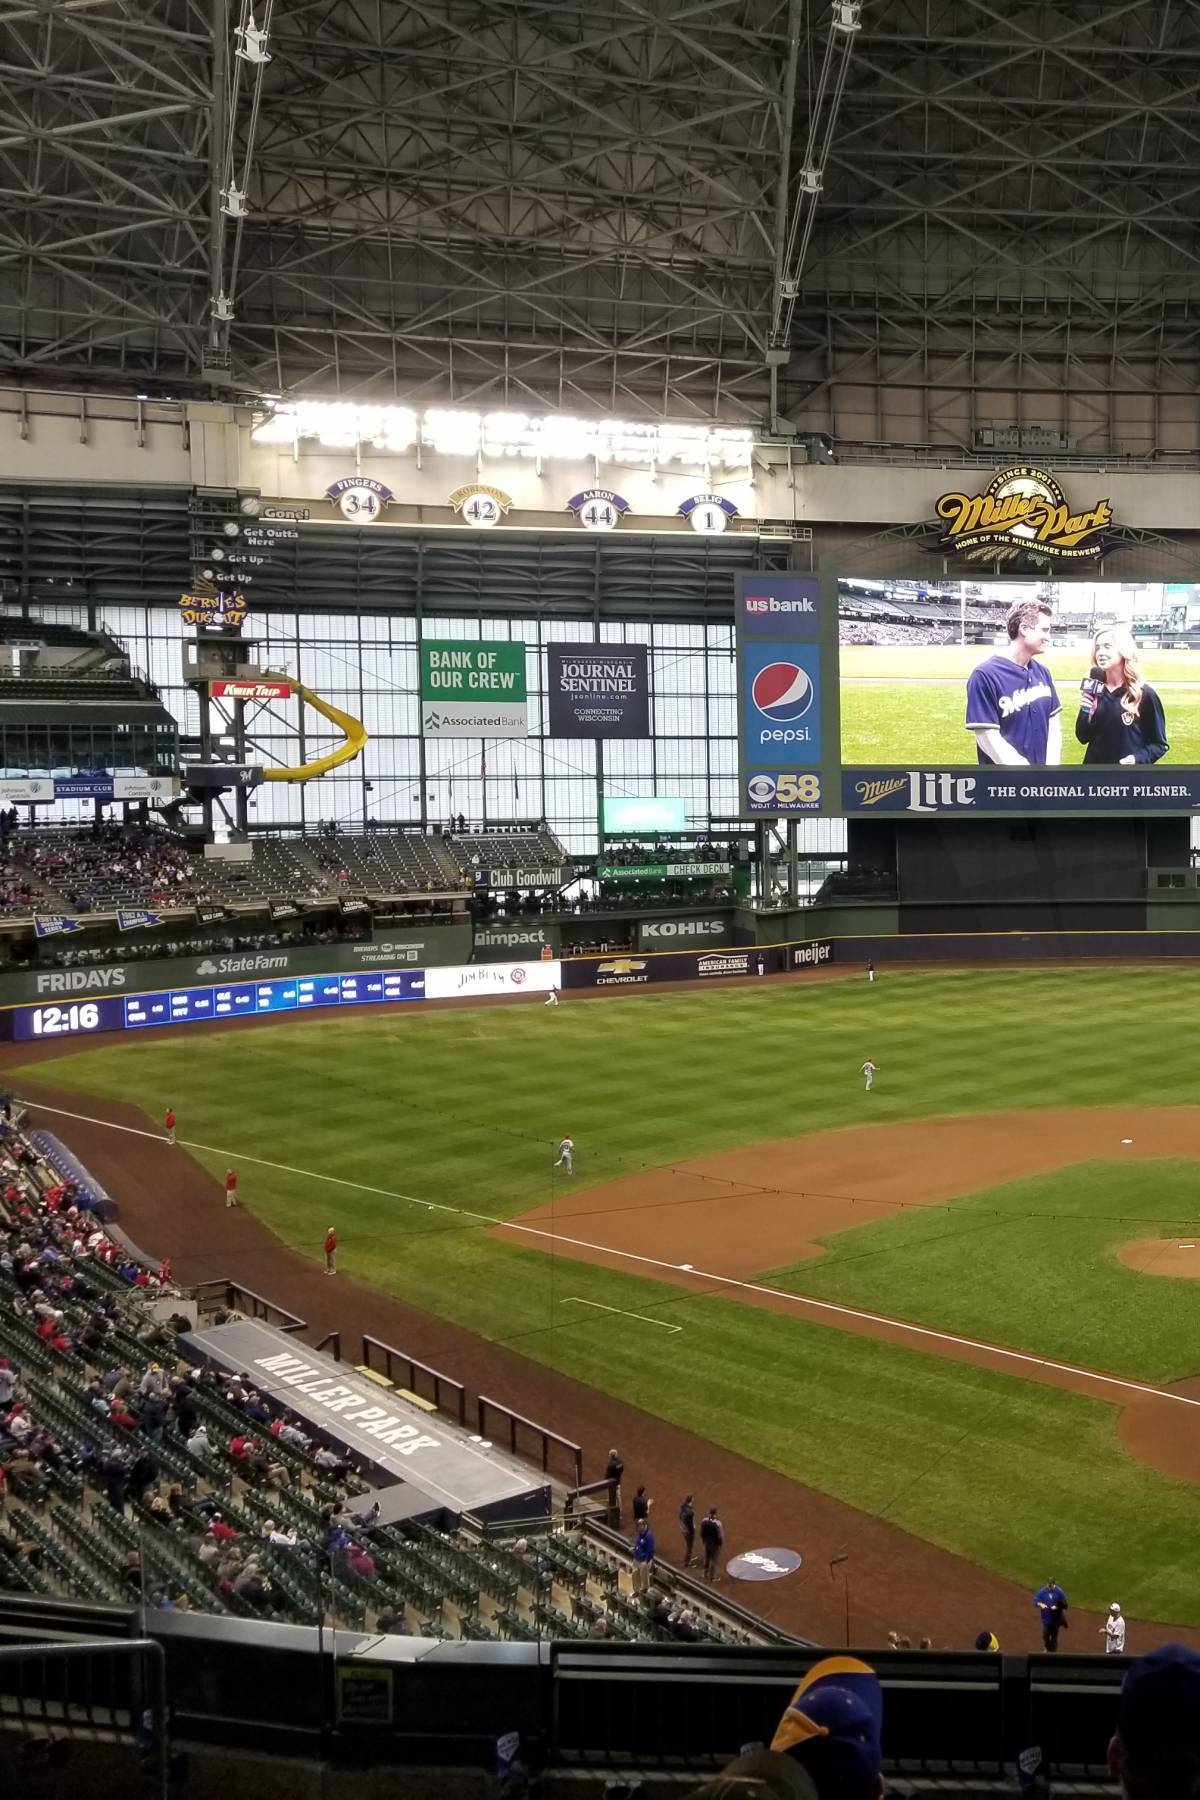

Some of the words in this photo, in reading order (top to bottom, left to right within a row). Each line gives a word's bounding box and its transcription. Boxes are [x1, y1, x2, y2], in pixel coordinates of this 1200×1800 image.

[336, 478, 382, 492] FINGERS
[998, 468, 1028, 485] SINCE
[1030, 470, 1052, 485] 2001
[583, 490, 614, 501] AARON
[694, 496, 722, 504] SELIG
[346, 494, 376, 515] 34
[466, 500, 496, 520] 42
[264, 508, 310, 520] Gone!
[585, 506, 614, 525] 44
[704, 512, 714, 530] 1
[937, 492, 1046, 536] Miller
[1026, 499, 1113, 546] Park
[244, 528, 264, 538] Get
[266, 528, 298, 538] Outta
[248, 538, 275, 546] Here
[955, 536, 978, 550] HOME
[980, 534, 991, 542] OF
[993, 534, 1010, 542] THE
[1012, 536, 1060, 556] MILWAUKEE
[1061, 546, 1101, 558] BREWERS
[228, 555, 247, 563] Get
[250, 556, 264, 565] Up
[238, 574, 252, 584] Up
[430, 652, 472, 668] BANK
[477, 652, 497, 669] OF
[430, 671, 464, 688] OUR
[560, 664, 636, 678] JOURNAL
[560, 678, 637, 692] SENTINEL
[775, 774, 820, 802] 58
[854, 778, 907, 805] Miller
[906, 772, 976, 812] Lite
[988, 786, 1016, 797] THE
[1020, 786, 1085, 797] ORIGINAL
[1088, 786, 1130, 797] LIGHT
[1133, 786, 1192, 797] PILSNER.
[491, 870, 515, 887] Club
[516, 868, 562, 886] Goodwill
[674, 865, 700, 874] CHECK
[703, 864, 724, 874] DECK
[642, 921, 724, 937] KOHL'S
[485, 930, 545, 947] impact
[794, 944, 831, 964] meijer
[37, 968, 126, 993] FRIDAYS
[596, 976, 648, 984] CHEVROLET
[33, 1004, 98, 1034] 12:16
[253, 1352, 366, 1420] MILLER
[350, 1405, 442, 1456] PARK
